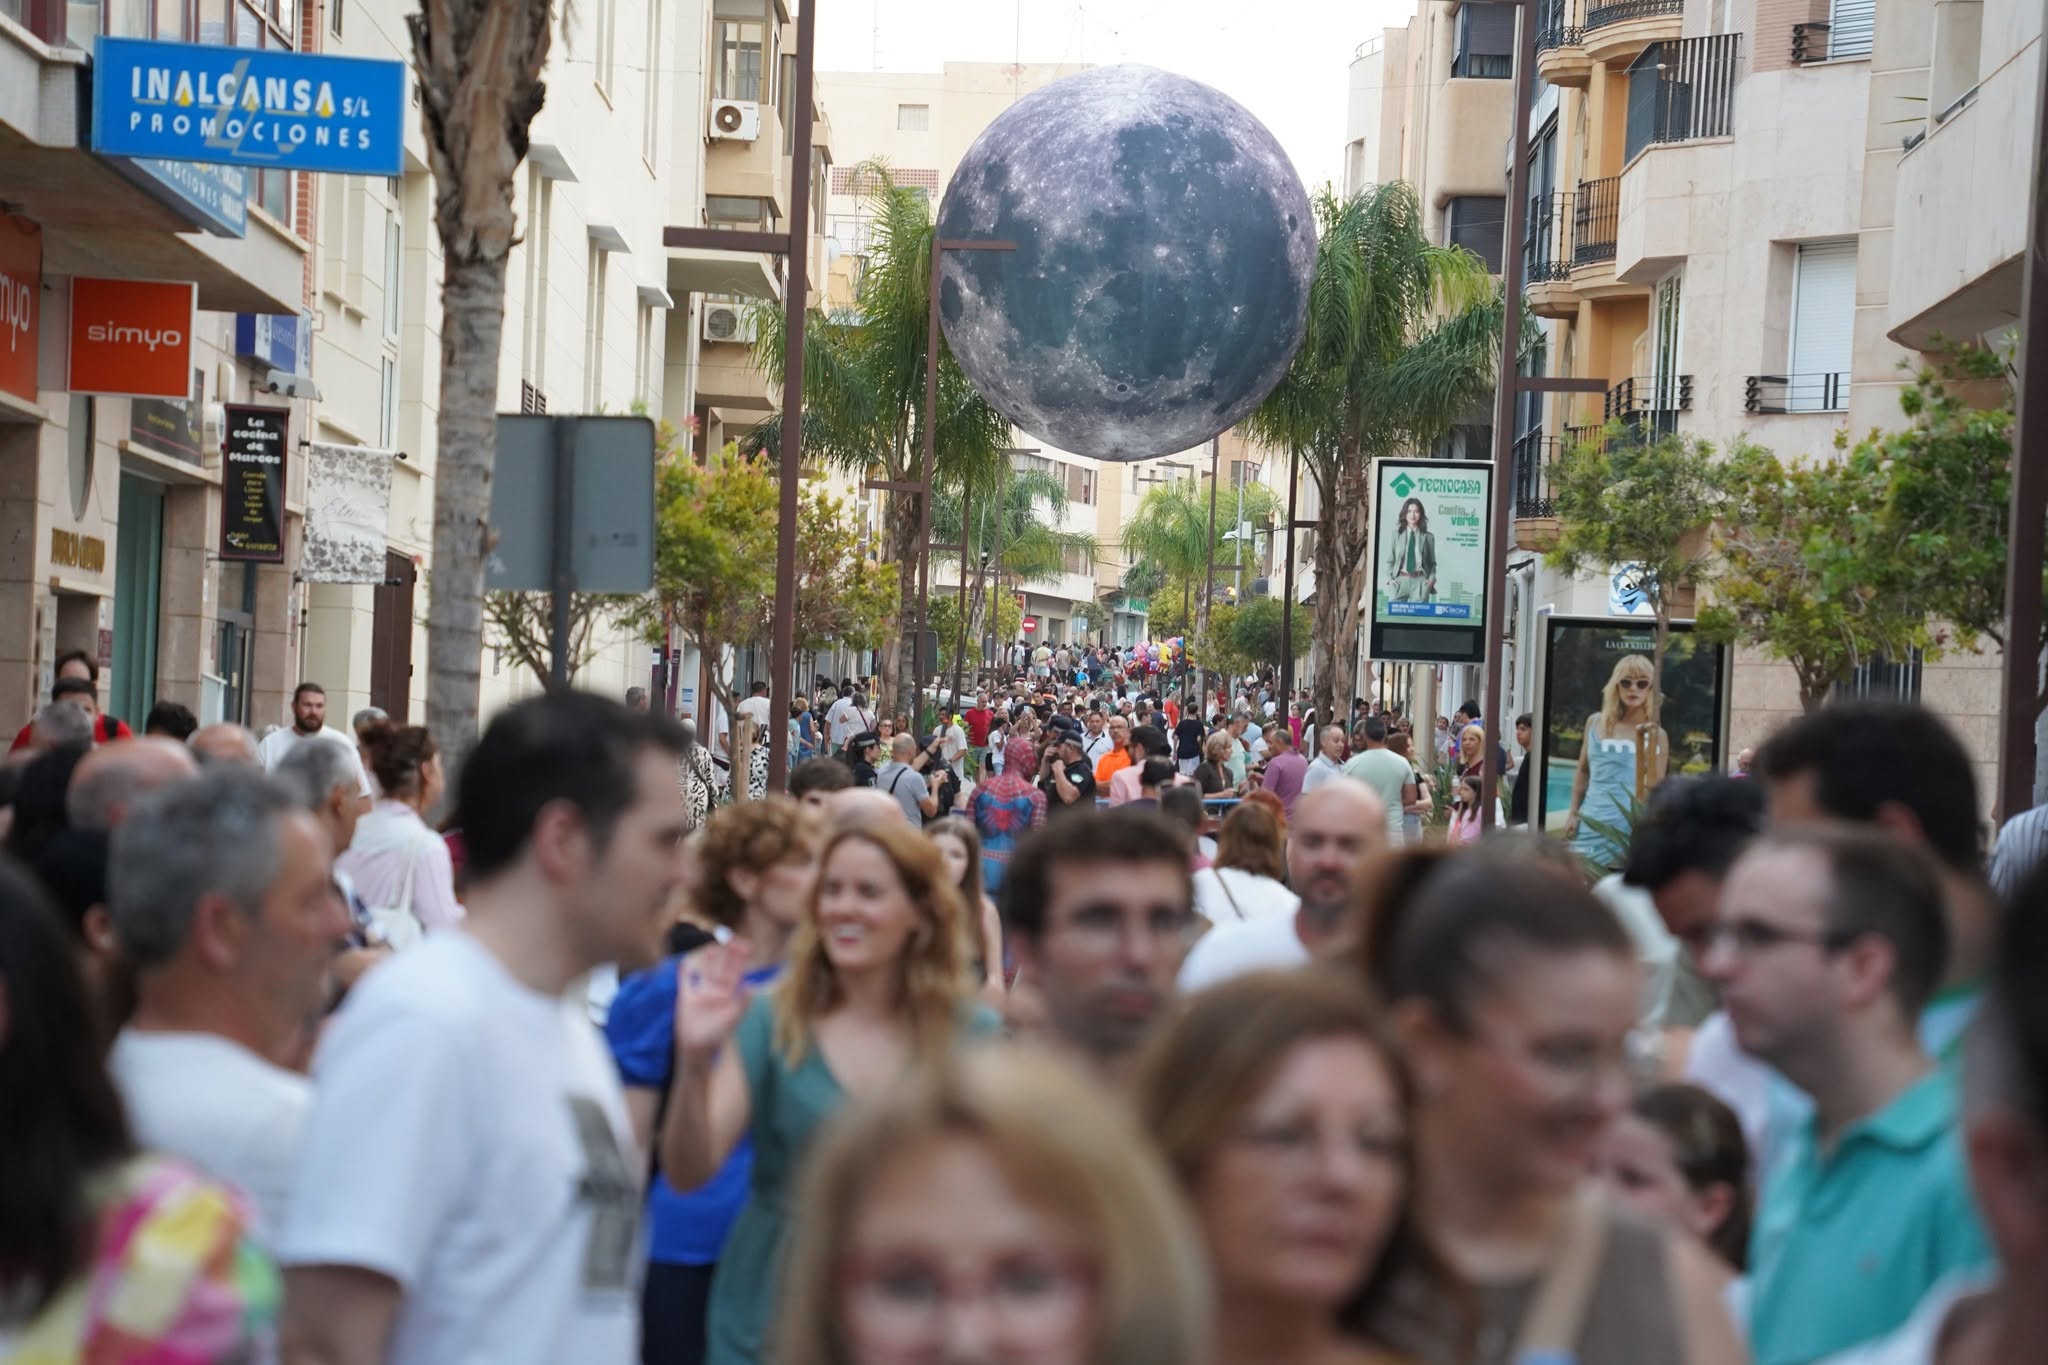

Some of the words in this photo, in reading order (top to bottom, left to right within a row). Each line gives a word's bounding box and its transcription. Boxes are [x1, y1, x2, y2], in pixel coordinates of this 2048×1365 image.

[132, 66, 336, 117] INALCANSA
[343, 96, 371, 118] S/L
[130, 112, 370, 149] PROMOCIONES
[88, 321, 181, 352] simyo
[247, 417, 265, 428] La
[233, 429, 278, 440] cocina
[246, 442, 264, 452] de
[229, 452, 280, 464] Marcos
[1417, 478, 1481, 495] TECNOCASA
[1451, 515, 1480, 527] verde
